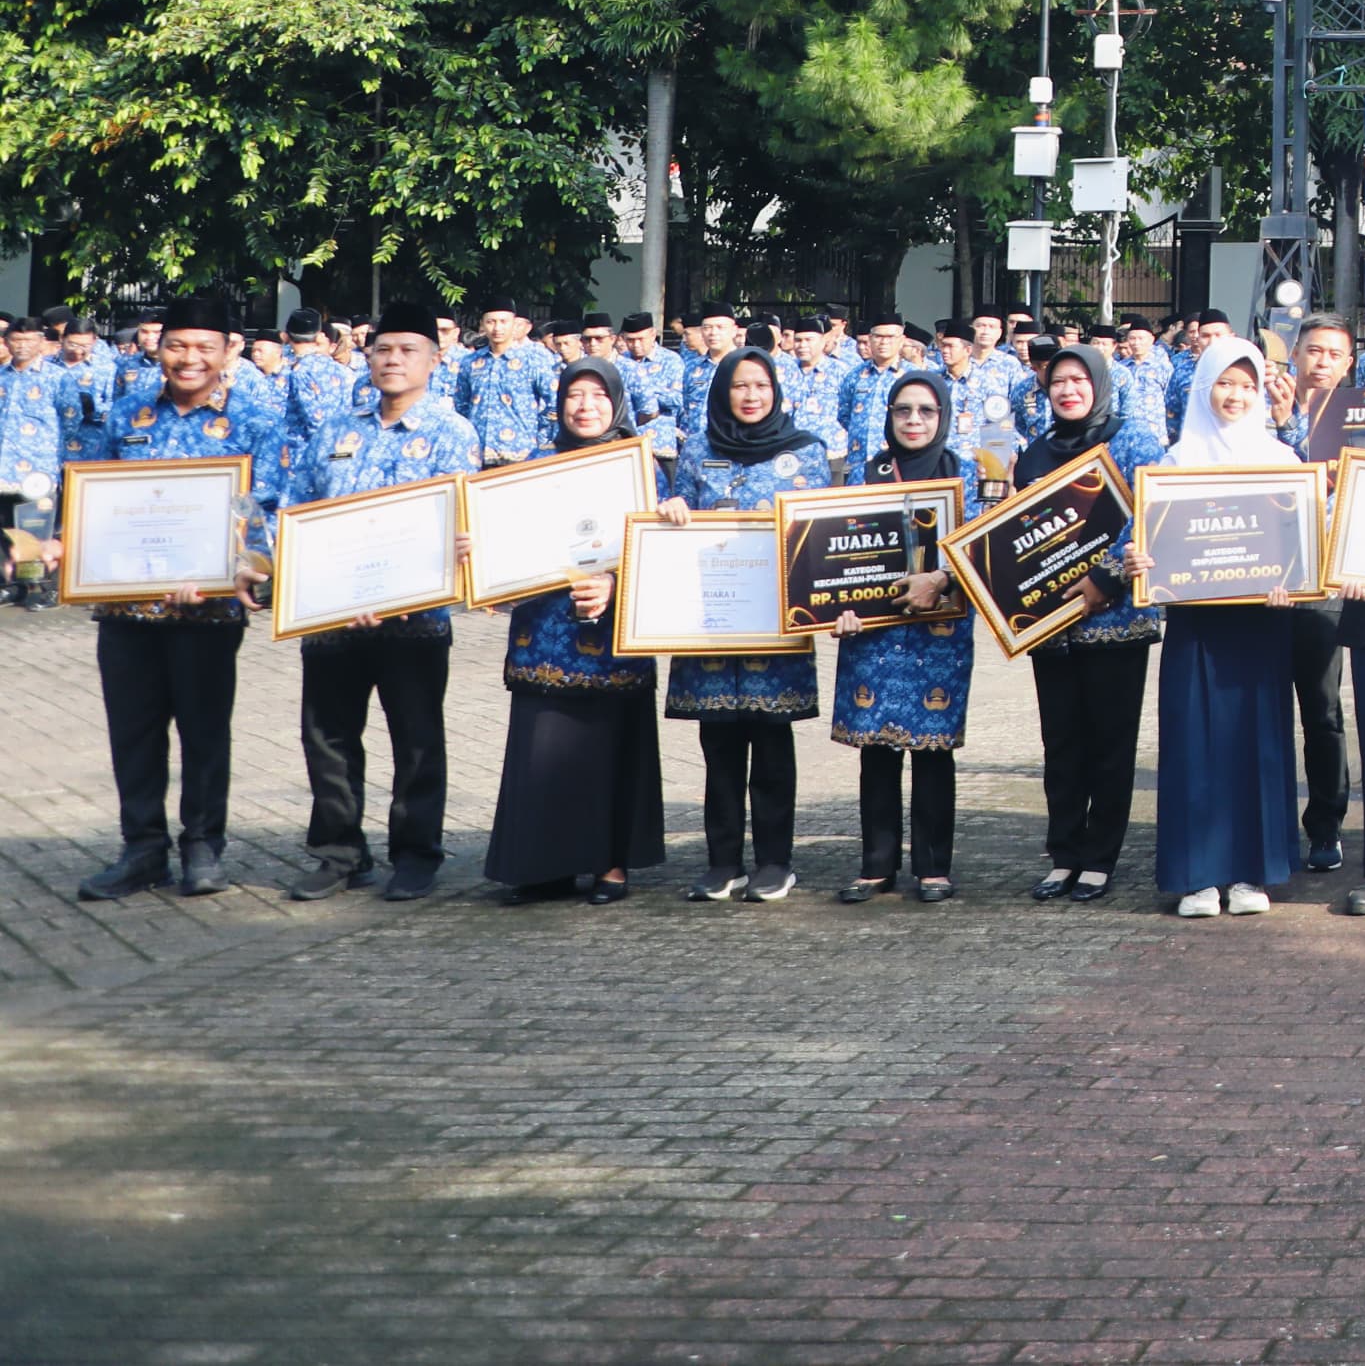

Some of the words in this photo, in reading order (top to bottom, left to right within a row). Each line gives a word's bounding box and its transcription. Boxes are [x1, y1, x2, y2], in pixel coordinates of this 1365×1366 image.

[1012, 515, 1068, 555] JUARA
[1064, 507, 1079, 523] 3
[1187, 515, 1247, 534] JUARA
[1250, 514, 1259, 528] 1
[827, 533, 885, 552] JUARA
[888, 531, 899, 546] 2
[1203, 546, 1247, 557] KATEGORI
[1040, 541, 1080, 568] KATEGORI
[843, 564, 885, 576] KATEGORI
[1170, 572, 1196, 584] RP.
[1199, 564, 1283, 583] 7.000.000
[809, 593, 836, 607] RP.
[839, 585, 899, 603] 5.000.0
[1021, 588, 1047, 608] RP.
